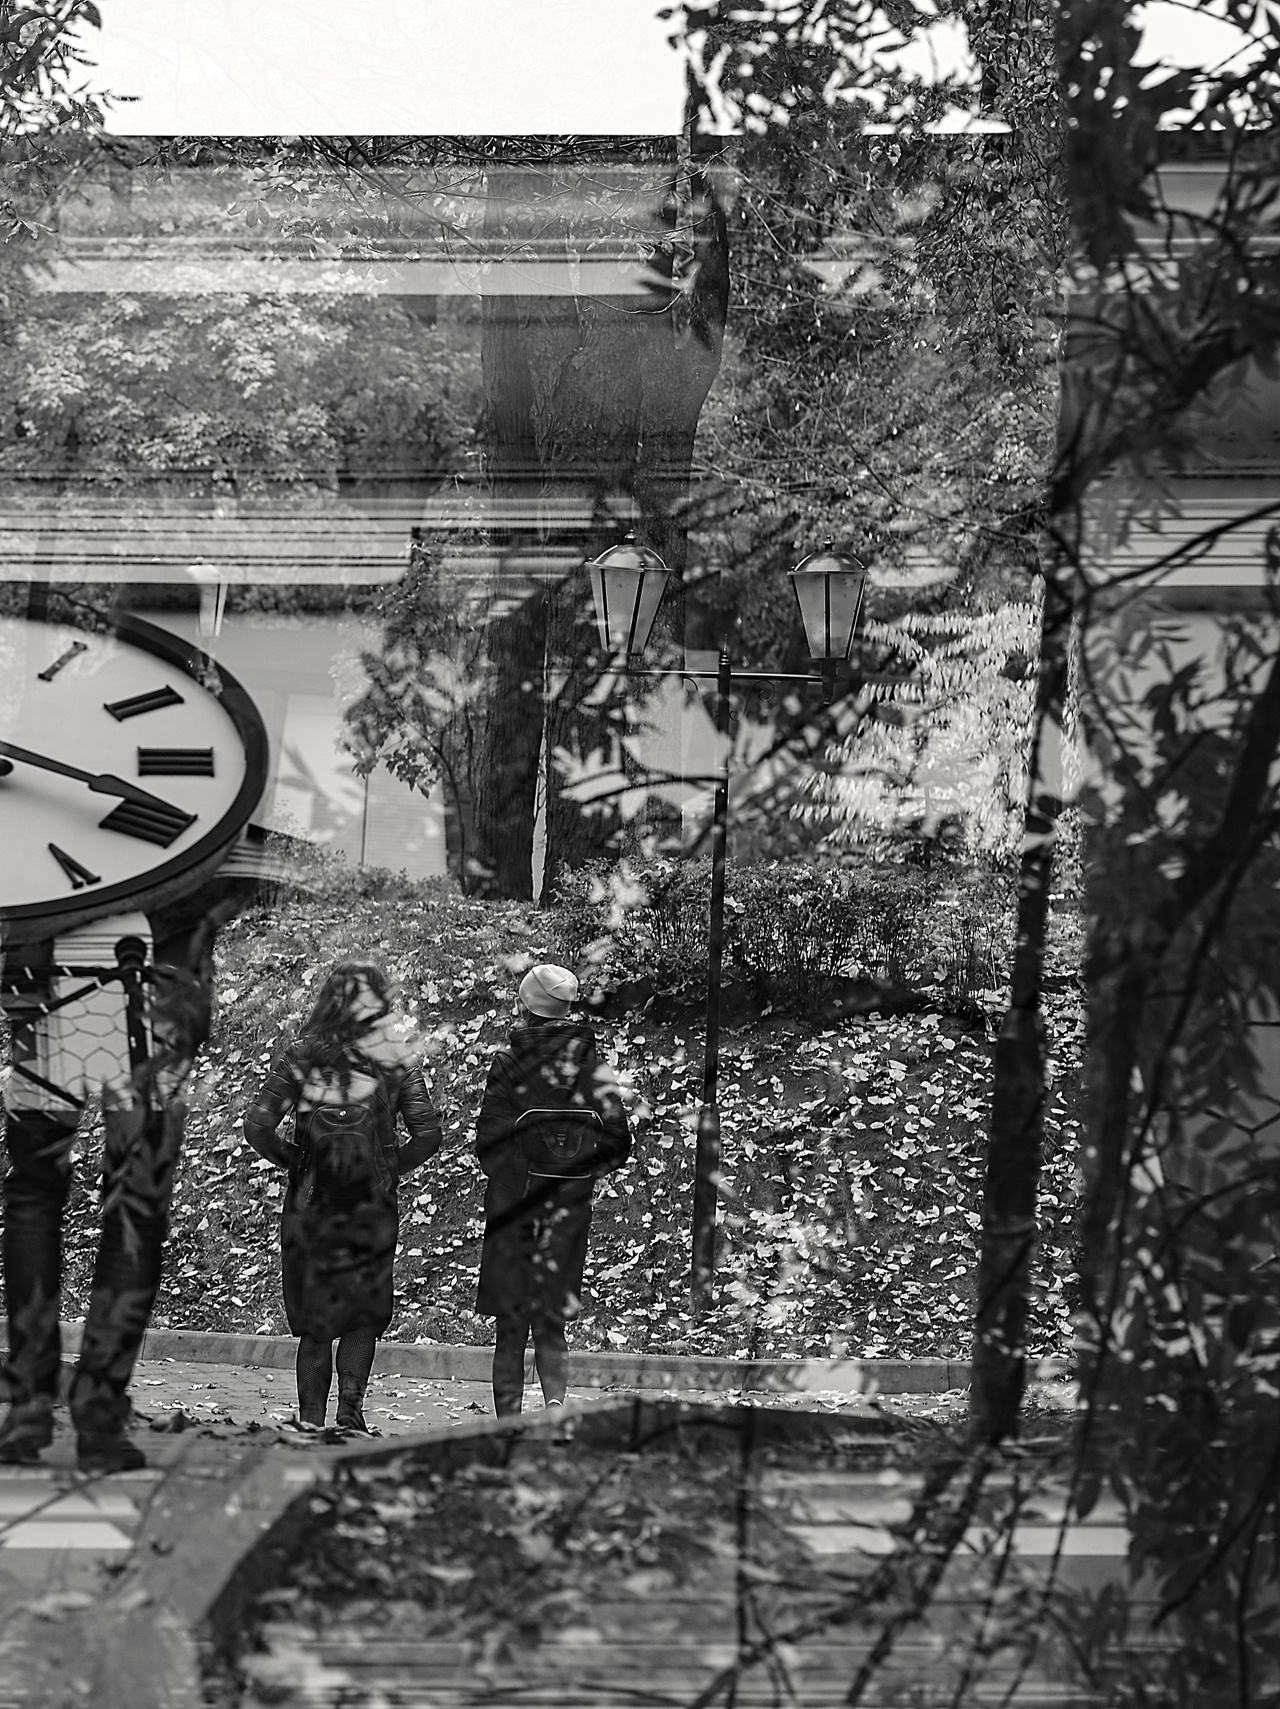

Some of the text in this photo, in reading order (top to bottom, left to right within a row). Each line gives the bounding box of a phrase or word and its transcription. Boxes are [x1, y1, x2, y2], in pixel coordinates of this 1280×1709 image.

[38, 640, 87, 682] I
[104, 684, 184, 722] II
[137, 745, 214, 777] III
[48, 843, 101, 889] V
